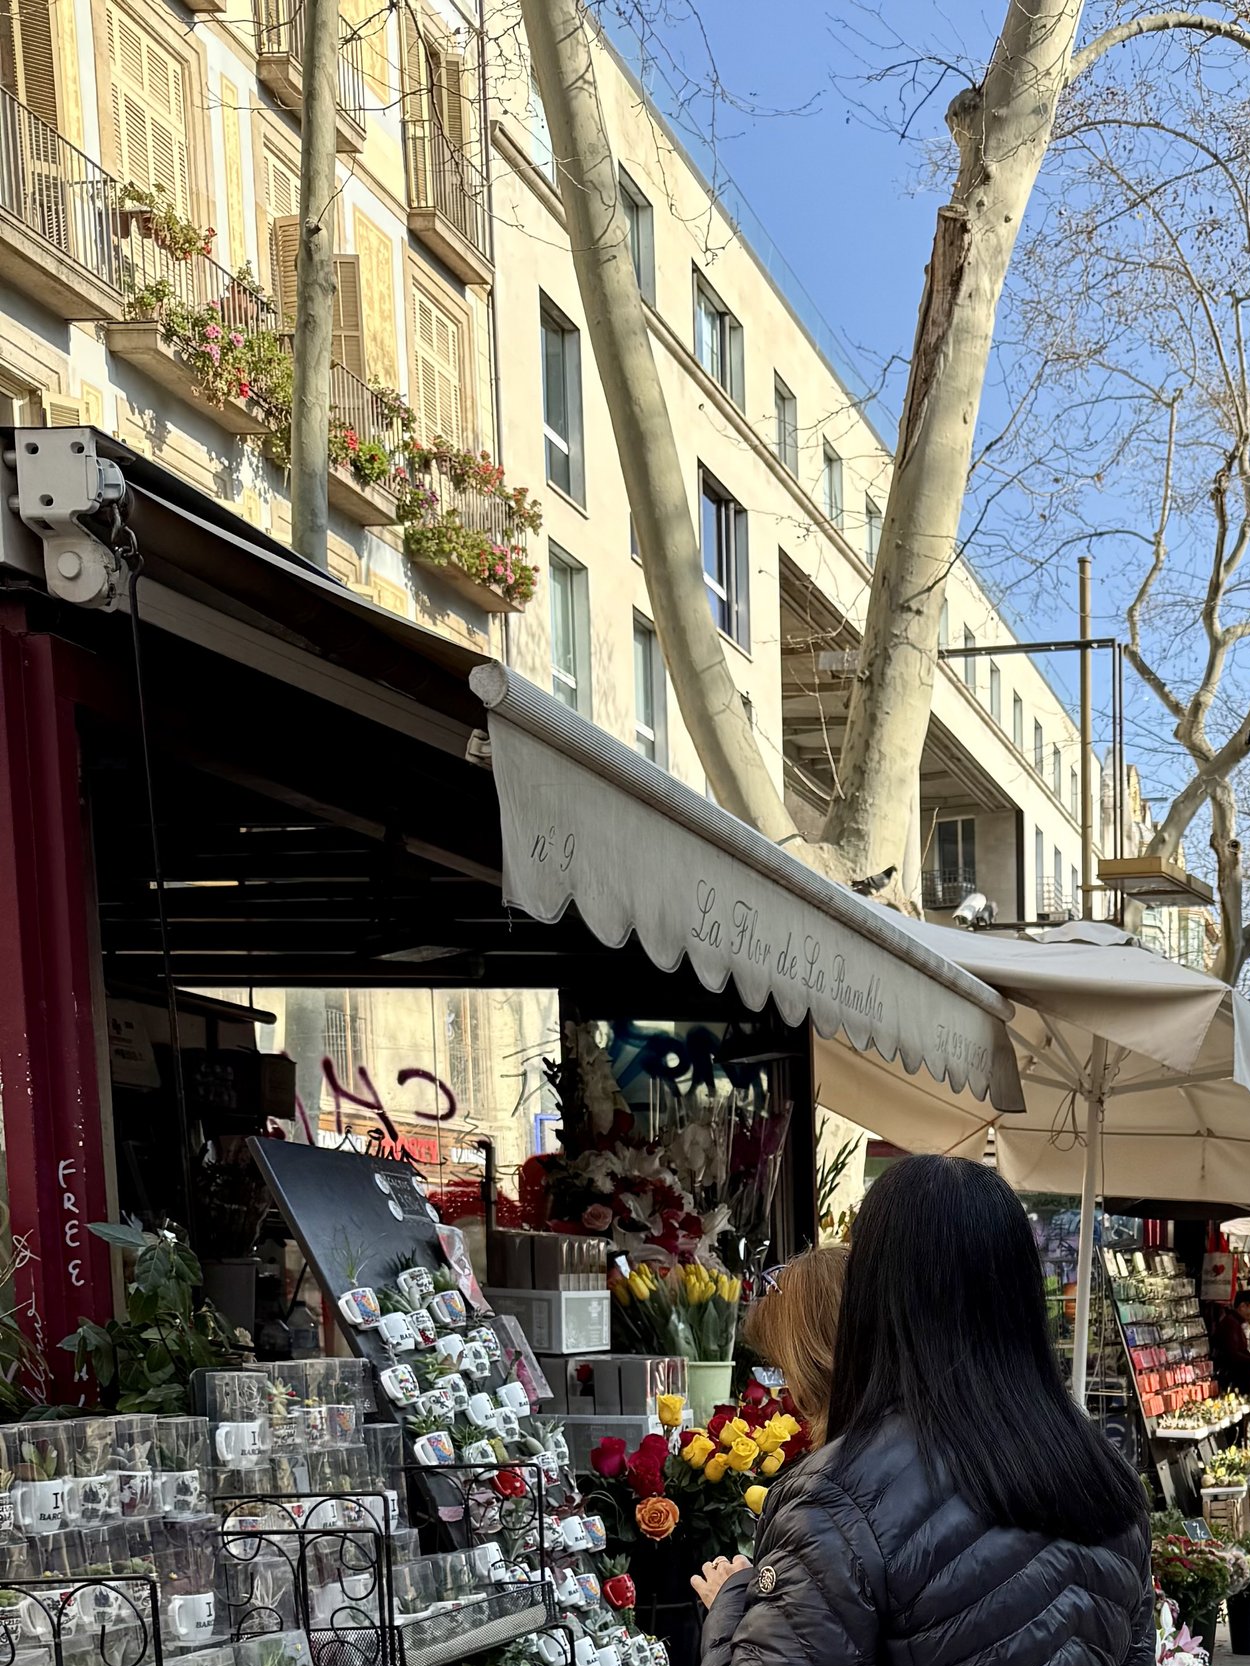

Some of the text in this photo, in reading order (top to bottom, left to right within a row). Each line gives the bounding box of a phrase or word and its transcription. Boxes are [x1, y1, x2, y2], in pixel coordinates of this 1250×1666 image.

[560, 833, 576, 872] 9
[691, 879, 884, 1024] La Flor de La Rambla
